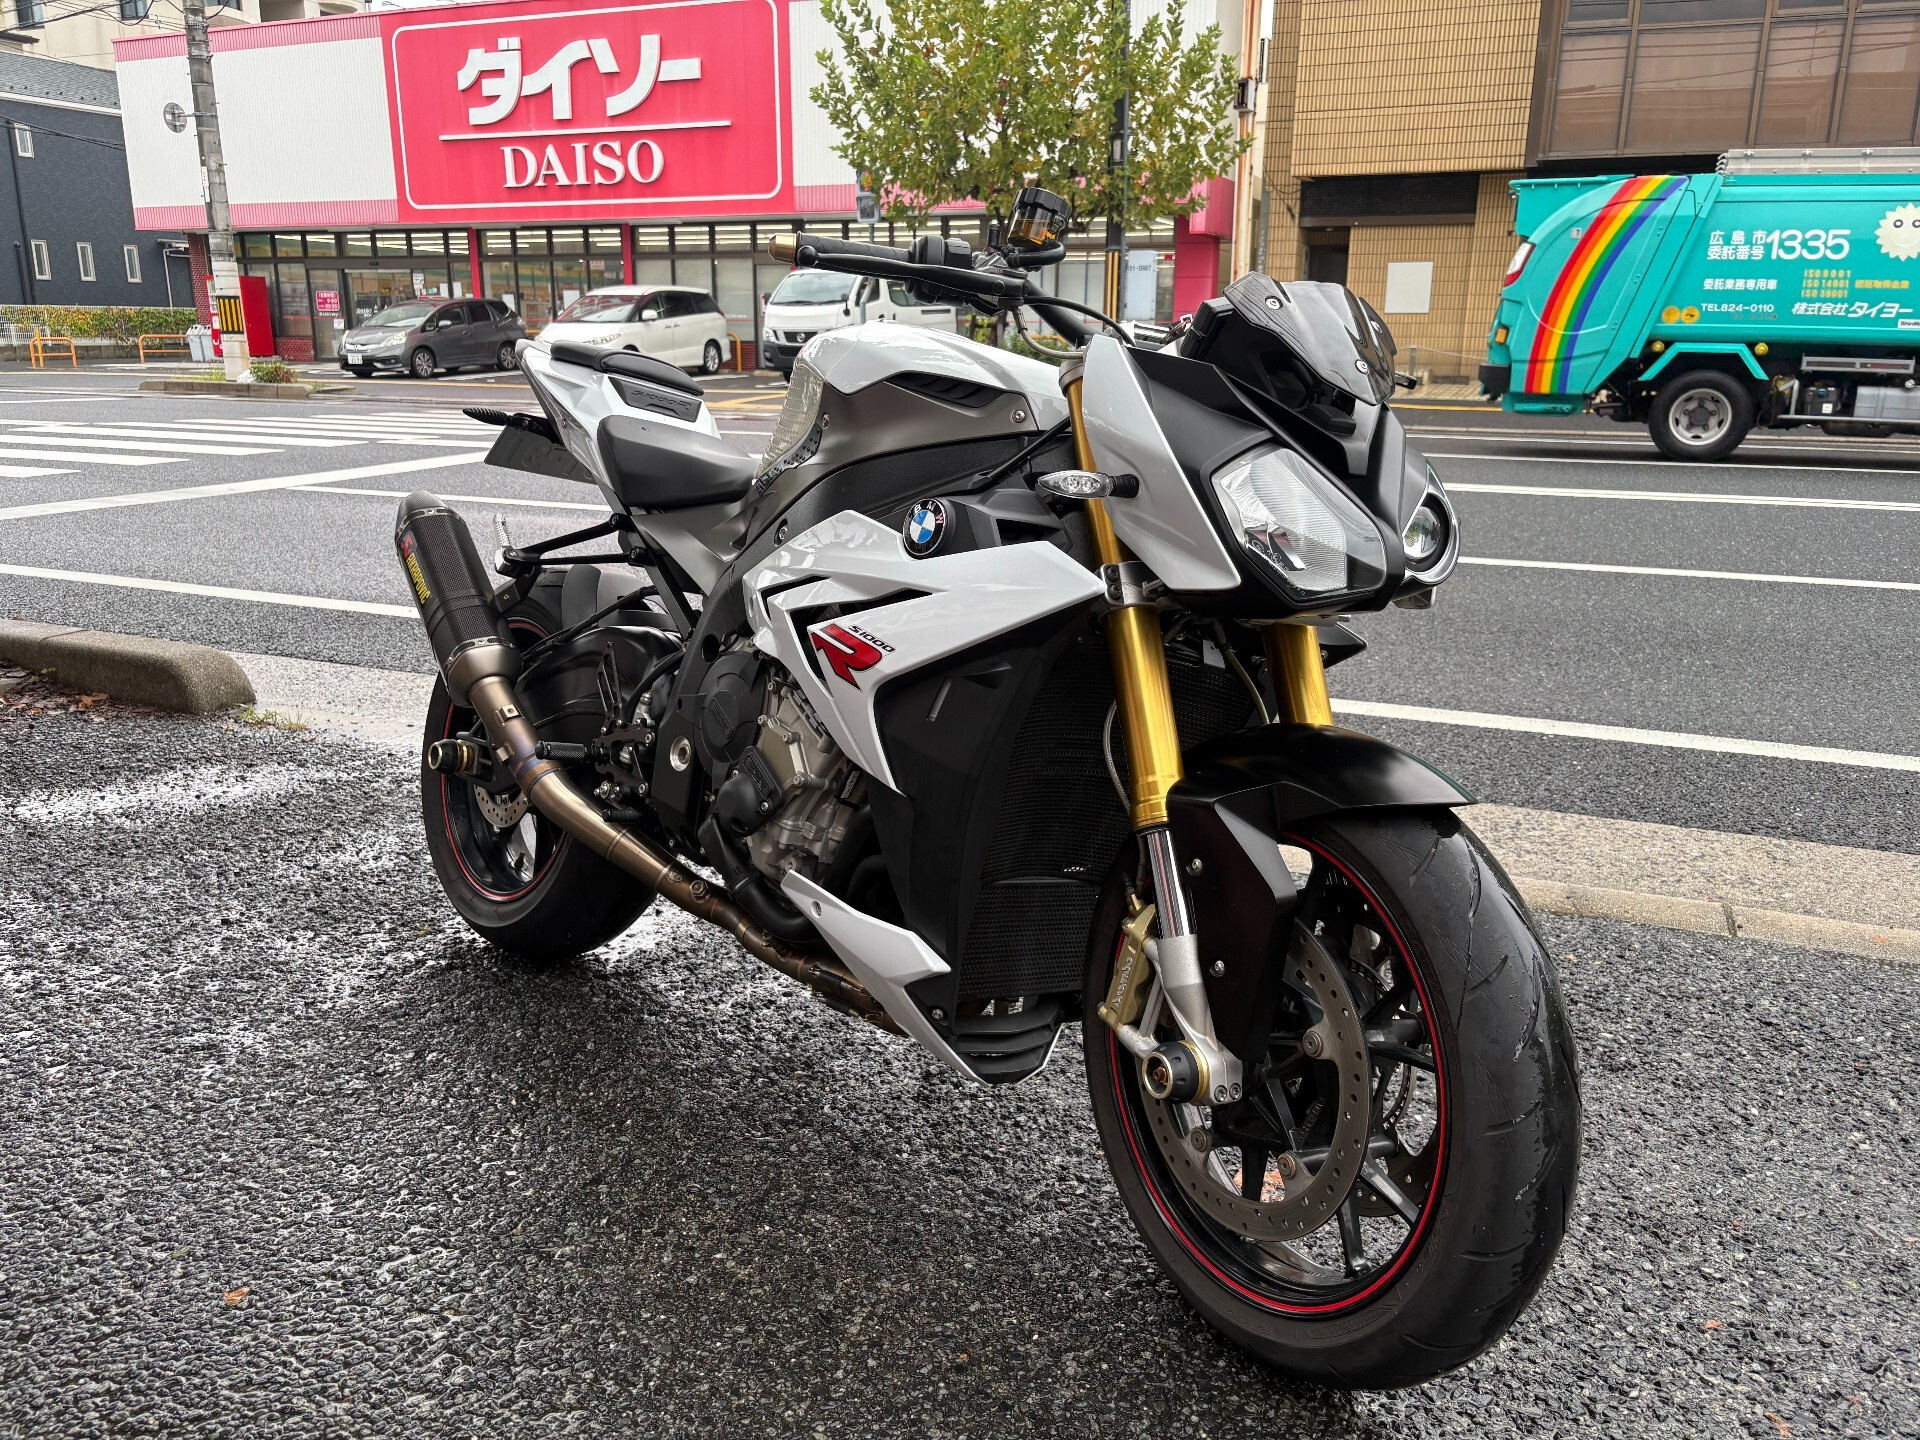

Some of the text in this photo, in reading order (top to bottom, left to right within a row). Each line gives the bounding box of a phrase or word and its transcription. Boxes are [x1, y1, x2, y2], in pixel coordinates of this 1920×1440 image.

[457, 34, 702, 126] ダイソー
[500, 139, 665, 188] DAISO
[1709, 229, 1768, 245] 広島市
[1765, 229, 1851, 260] 1335
[1706, 245, 1765, 260] 委託番号
[1703, 278, 1778, 290] 委託業務専用車
[913, 500, 944, 524] BMW
[848, 624, 896, 653] S1000
[810, 622, 883, 692] R
